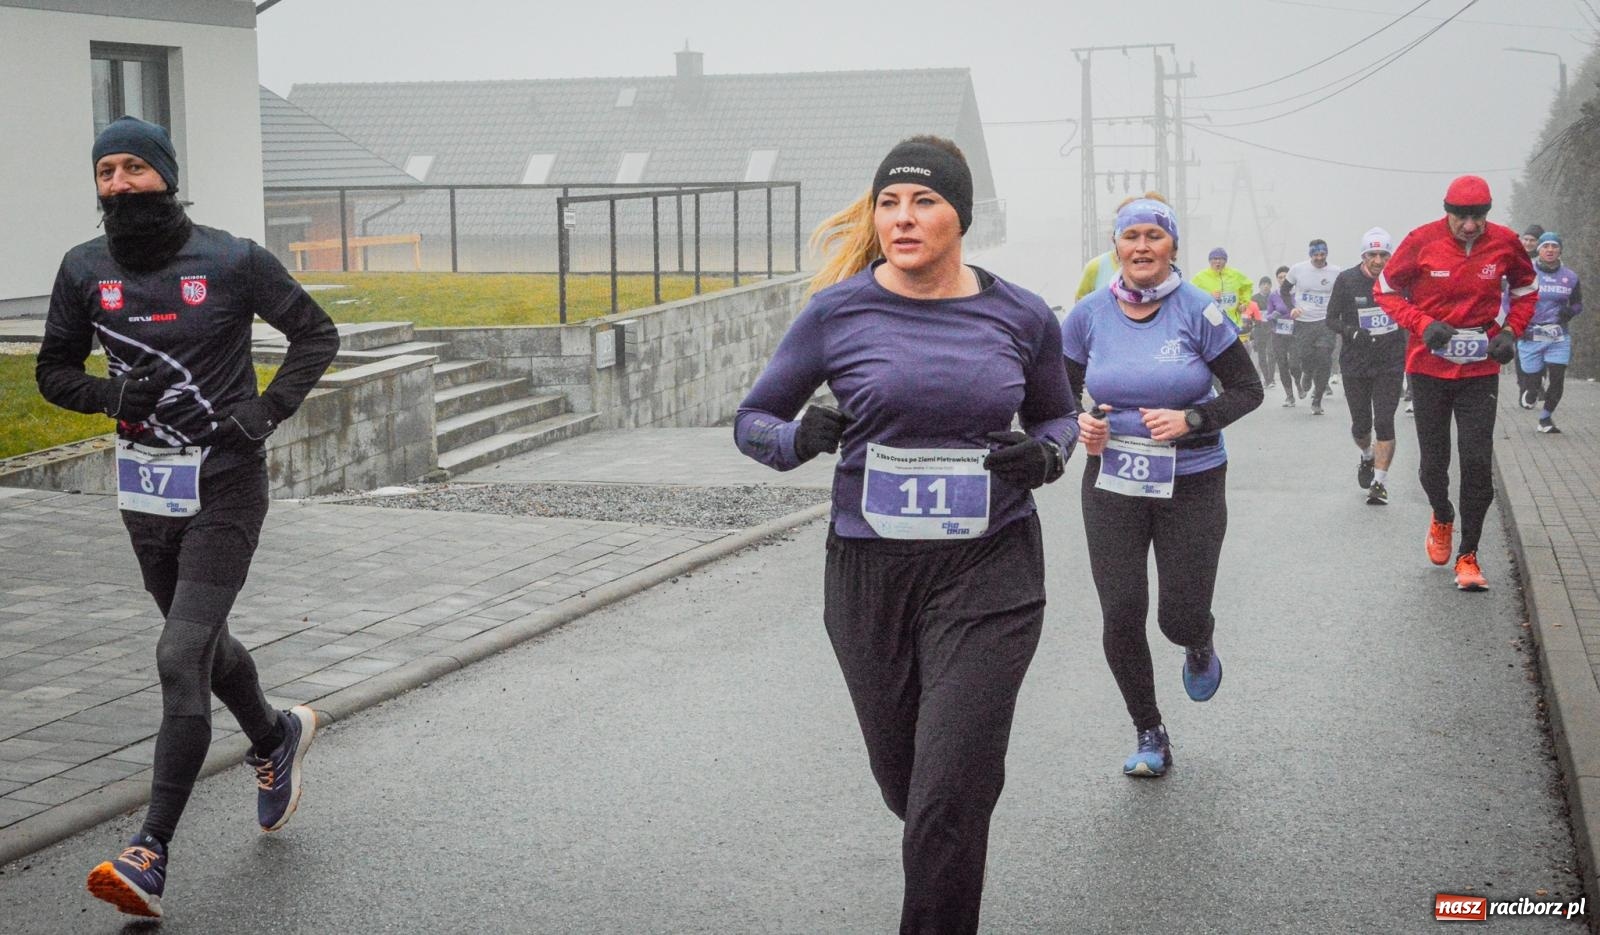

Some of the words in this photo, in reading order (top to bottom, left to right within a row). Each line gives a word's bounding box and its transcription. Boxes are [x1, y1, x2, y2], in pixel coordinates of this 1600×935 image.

[888, 166, 932, 176] ATOMIC
[1371, 314, 1389, 327] 80
[1443, 341, 1480, 356] 189
[1117, 453, 1150, 480] 28
[138, 466, 172, 495] 87
[899, 477, 951, 514] 11
